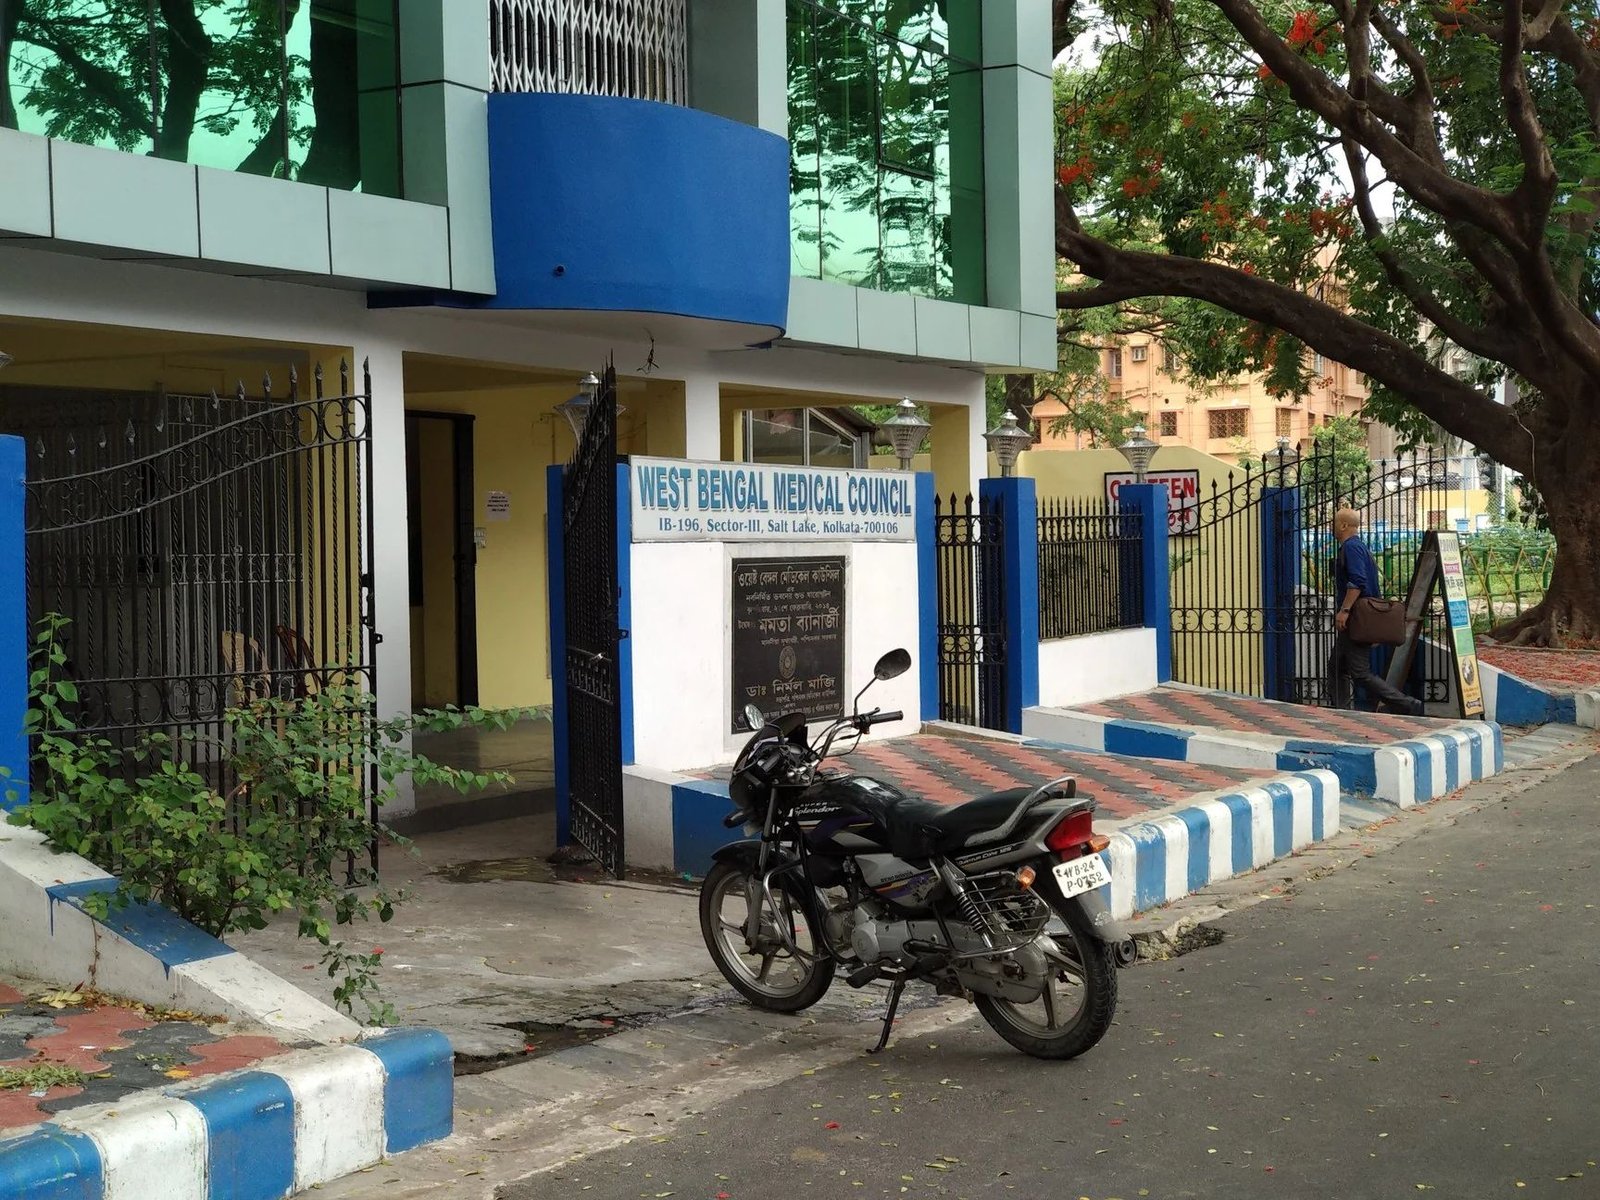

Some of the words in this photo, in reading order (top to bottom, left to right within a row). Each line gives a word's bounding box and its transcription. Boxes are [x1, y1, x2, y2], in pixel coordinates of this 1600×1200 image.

[637, 465, 692, 511] WEST
[697, 467, 769, 512] BENGAL
[773, 471, 844, 514] MEDICAL
[848, 476, 912, 516] COUNCIL
[659, 517, 704, 533] IB-196,
[706, 518, 765, 534] Sector-III,
[767, 519, 789, 533] Salt
[792, 520, 821, 534] Lake,
[823, 521, 899, 534] Kolkata-700106
[758, 616, 791, 634] মমতা
[745, 684, 767, 697] ডাঃ
[772, 676, 804, 694] নির্মল
[807, 673, 836, 690] মাজি
